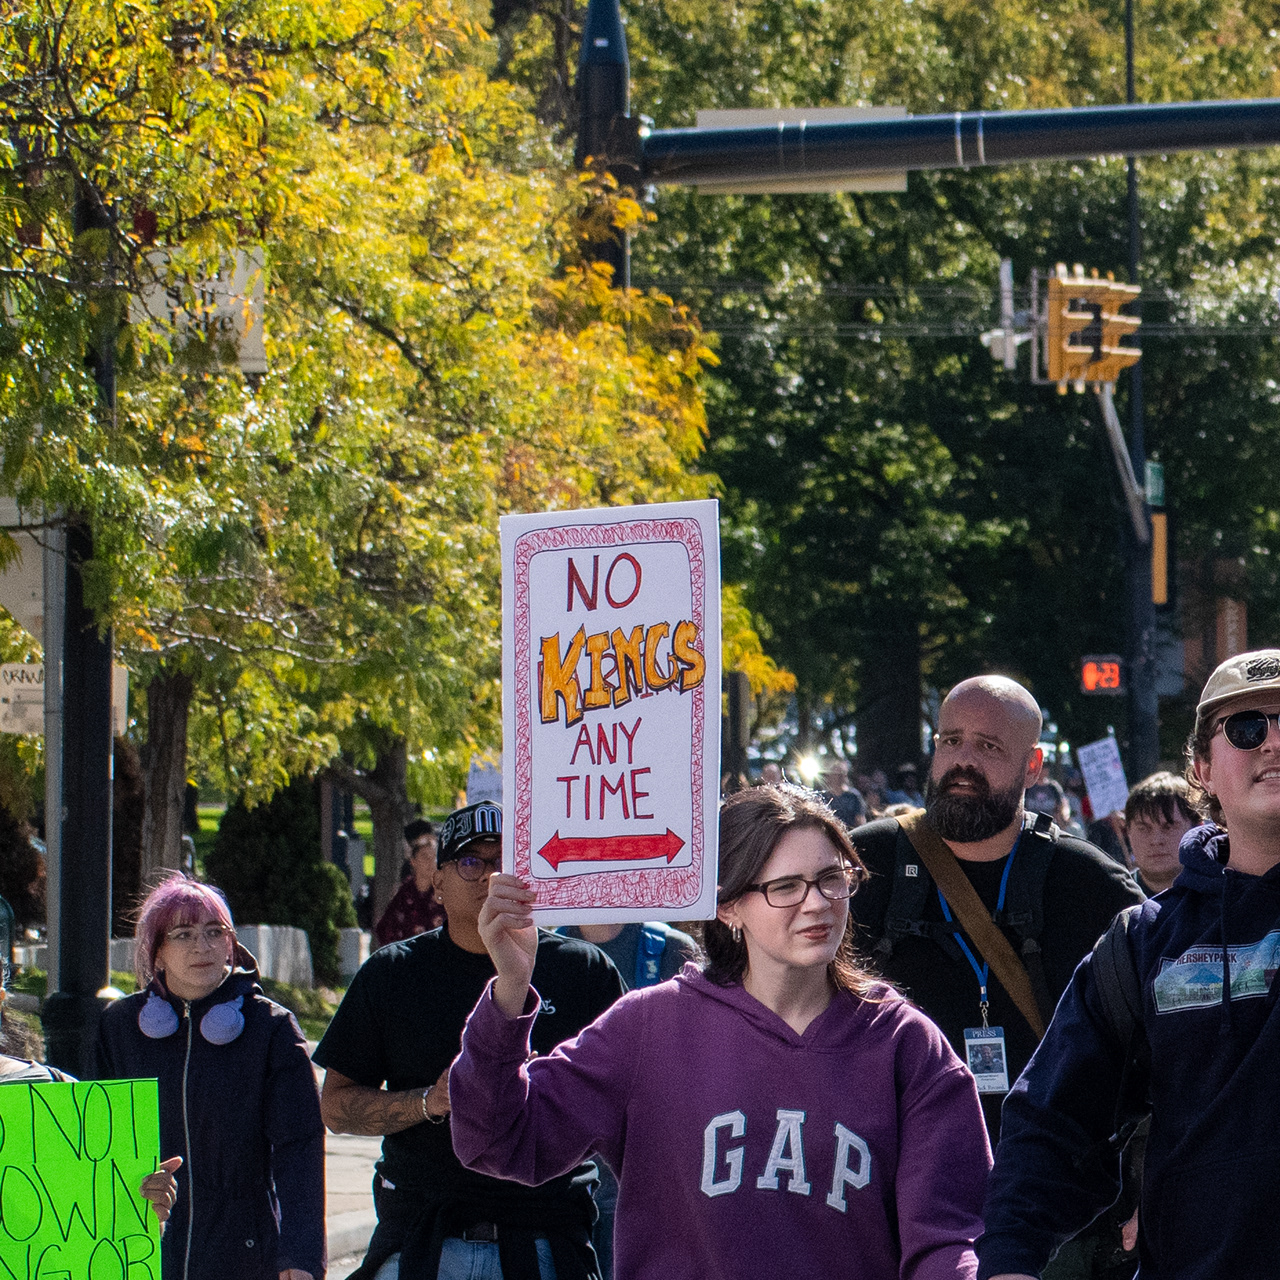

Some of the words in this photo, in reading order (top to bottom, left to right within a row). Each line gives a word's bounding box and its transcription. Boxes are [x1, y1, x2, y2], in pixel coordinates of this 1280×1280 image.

[566, 552, 642, 612] NO
[539, 619, 706, 728] KINGS
[570, 716, 643, 765] ANY
[556, 767, 655, 821] TIME
[1176, 952, 1238, 966] HERSHEYPAK
[972, 1029, 997, 1038] PRESS
[28, 1080, 158, 1162] NOT
[700, 1107, 872, 1213] GAP
